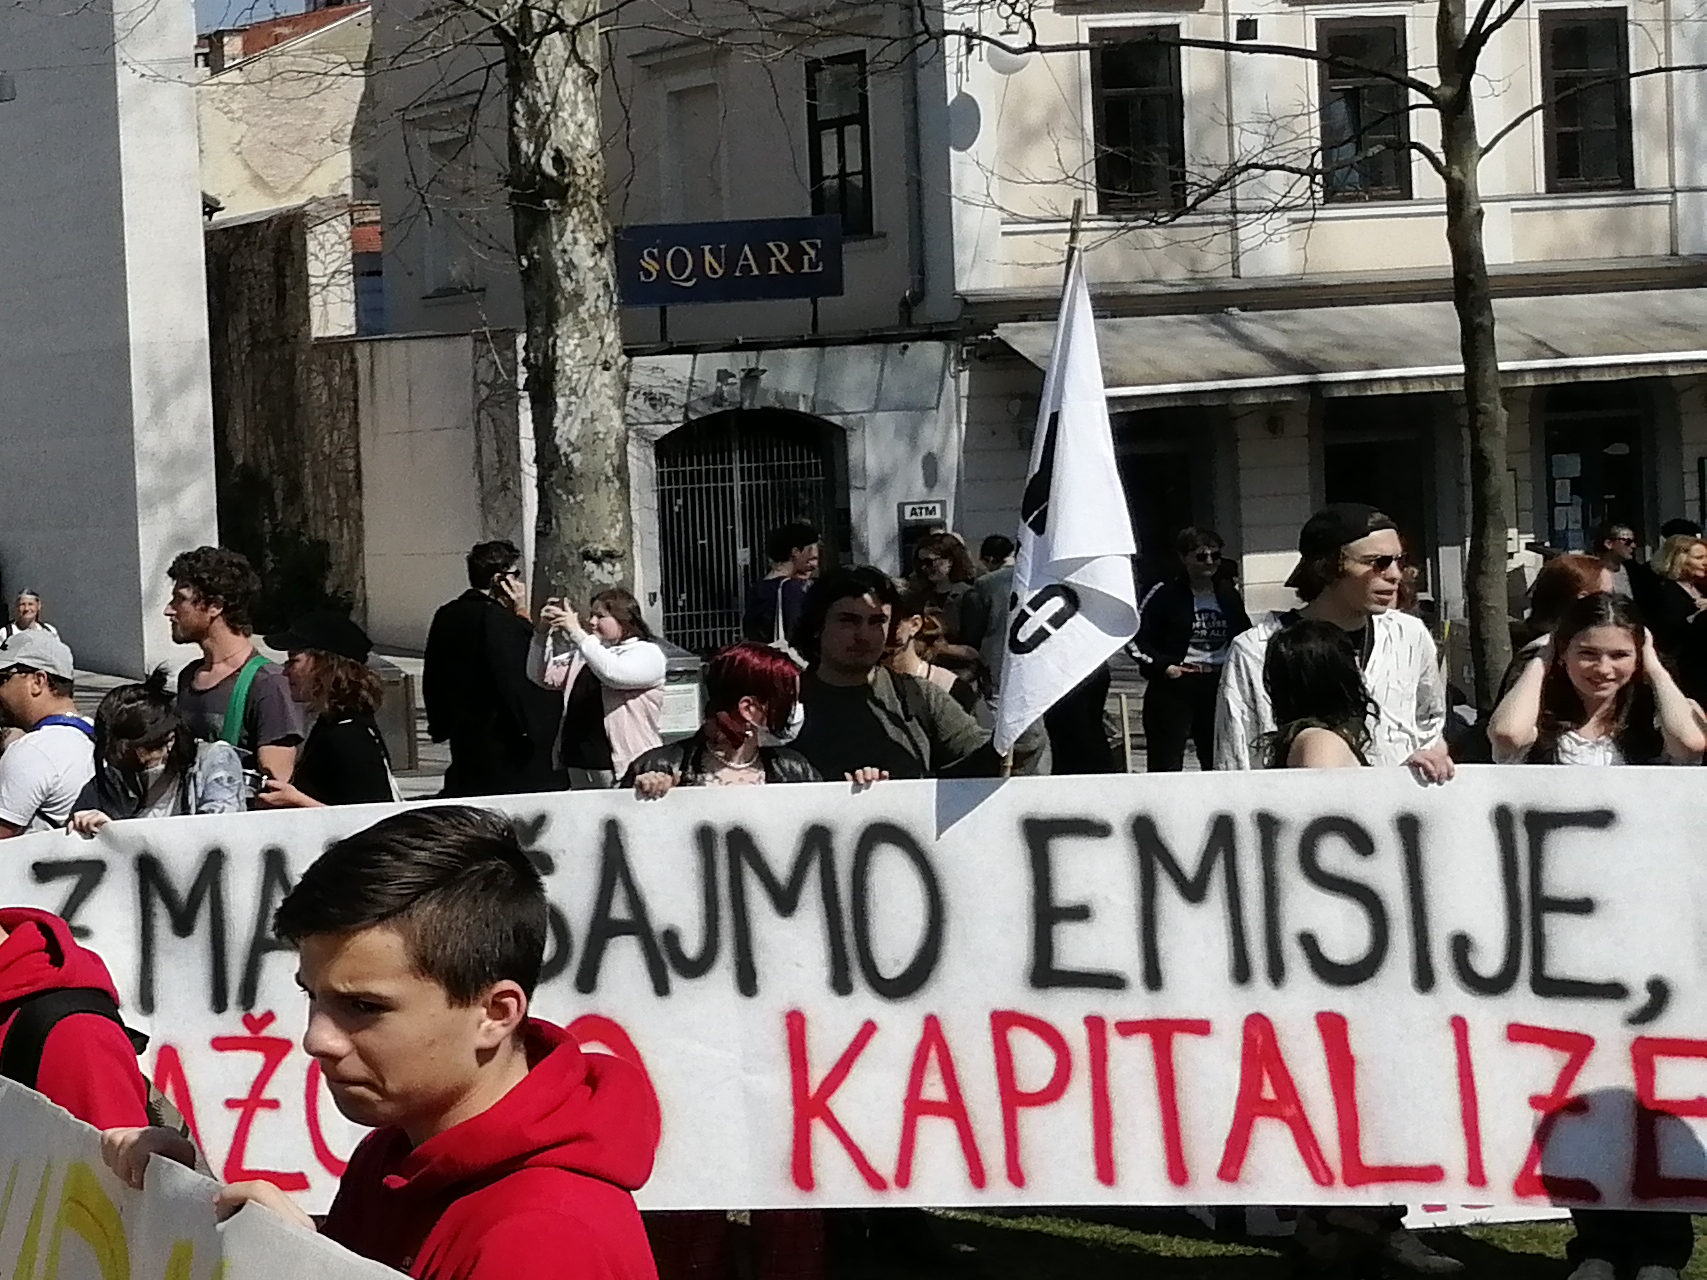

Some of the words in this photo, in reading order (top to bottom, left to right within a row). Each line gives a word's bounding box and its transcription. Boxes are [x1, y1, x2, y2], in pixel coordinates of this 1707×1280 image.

[639, 238, 824, 288] SQUARE
[909, 505, 937, 517] ATM
[1021, 804, 1671, 1027] EMISIJE,
